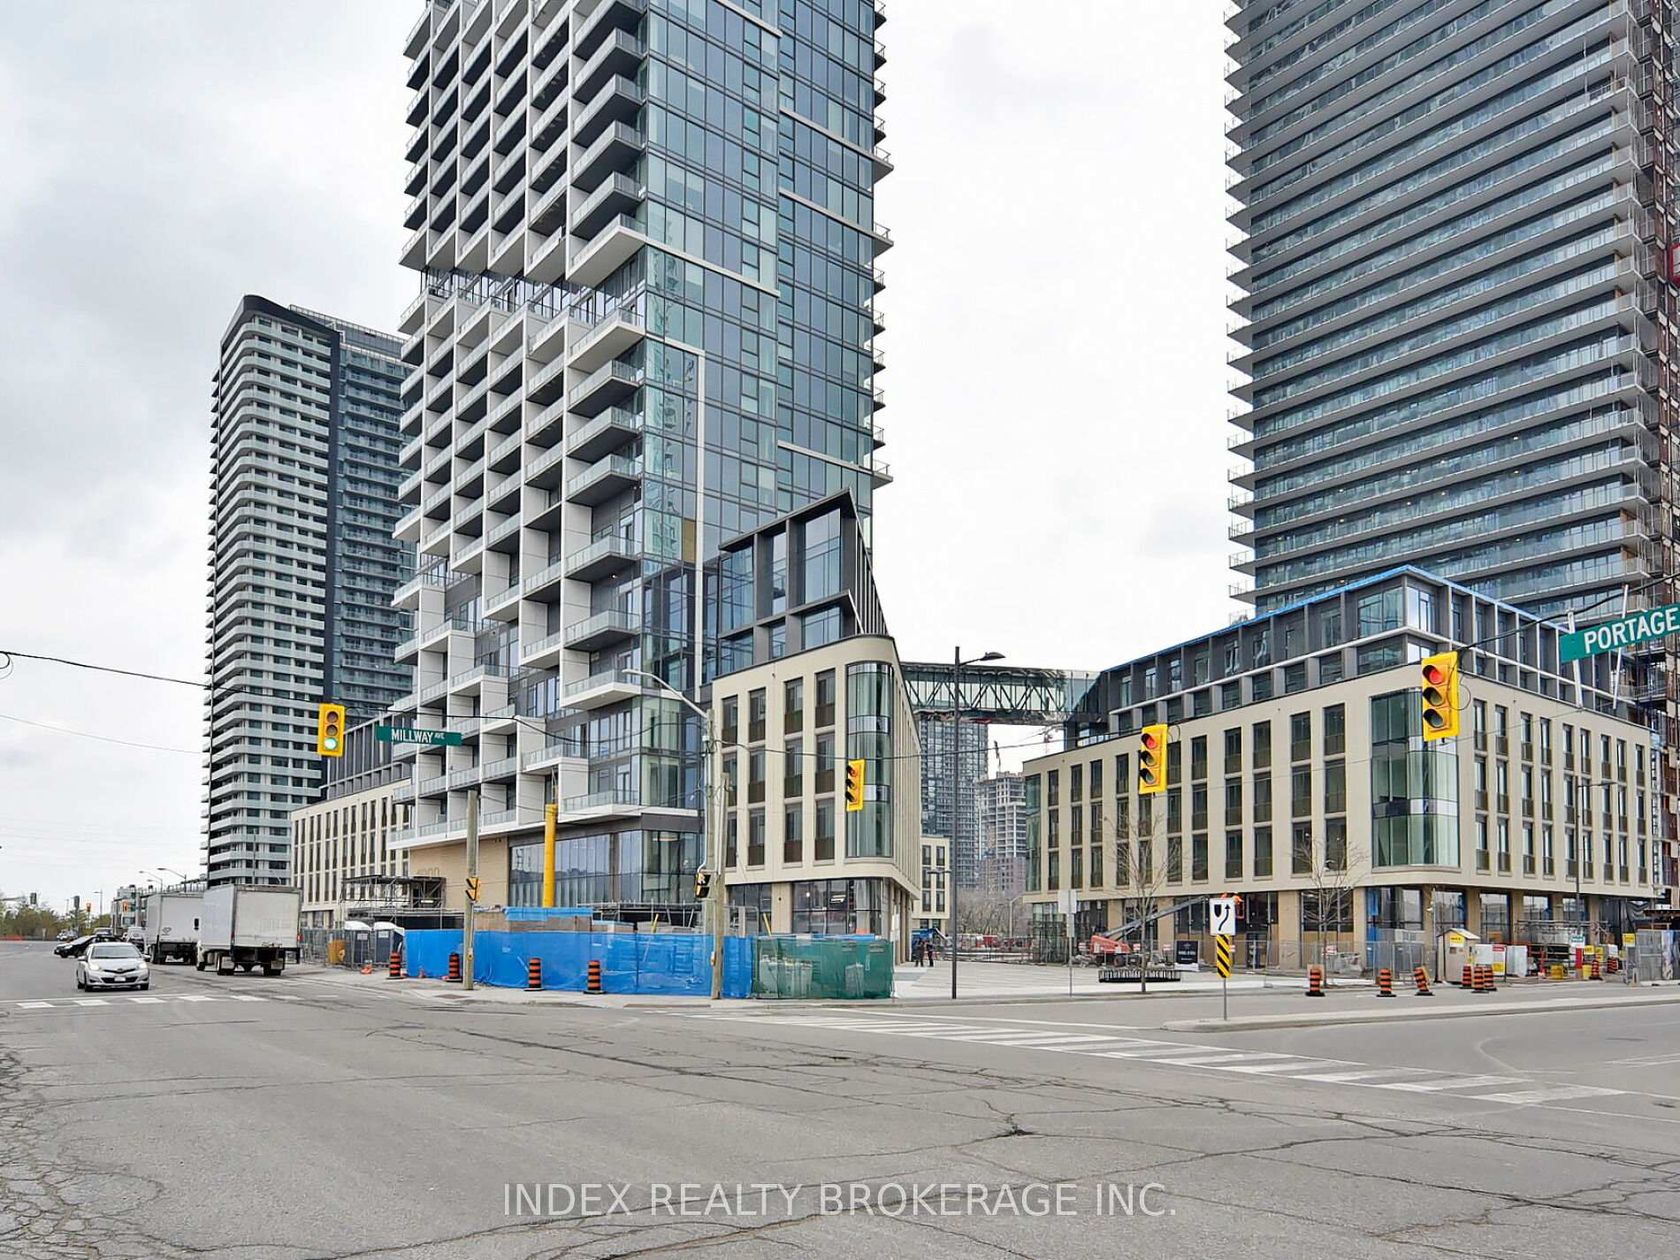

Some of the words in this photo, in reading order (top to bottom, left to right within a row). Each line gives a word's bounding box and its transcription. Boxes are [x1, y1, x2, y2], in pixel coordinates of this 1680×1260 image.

[1583, 607, 1680, 654] PORTAGE
[391, 728, 433, 743] MILLWAY
[434, 732, 446, 740] AVE
